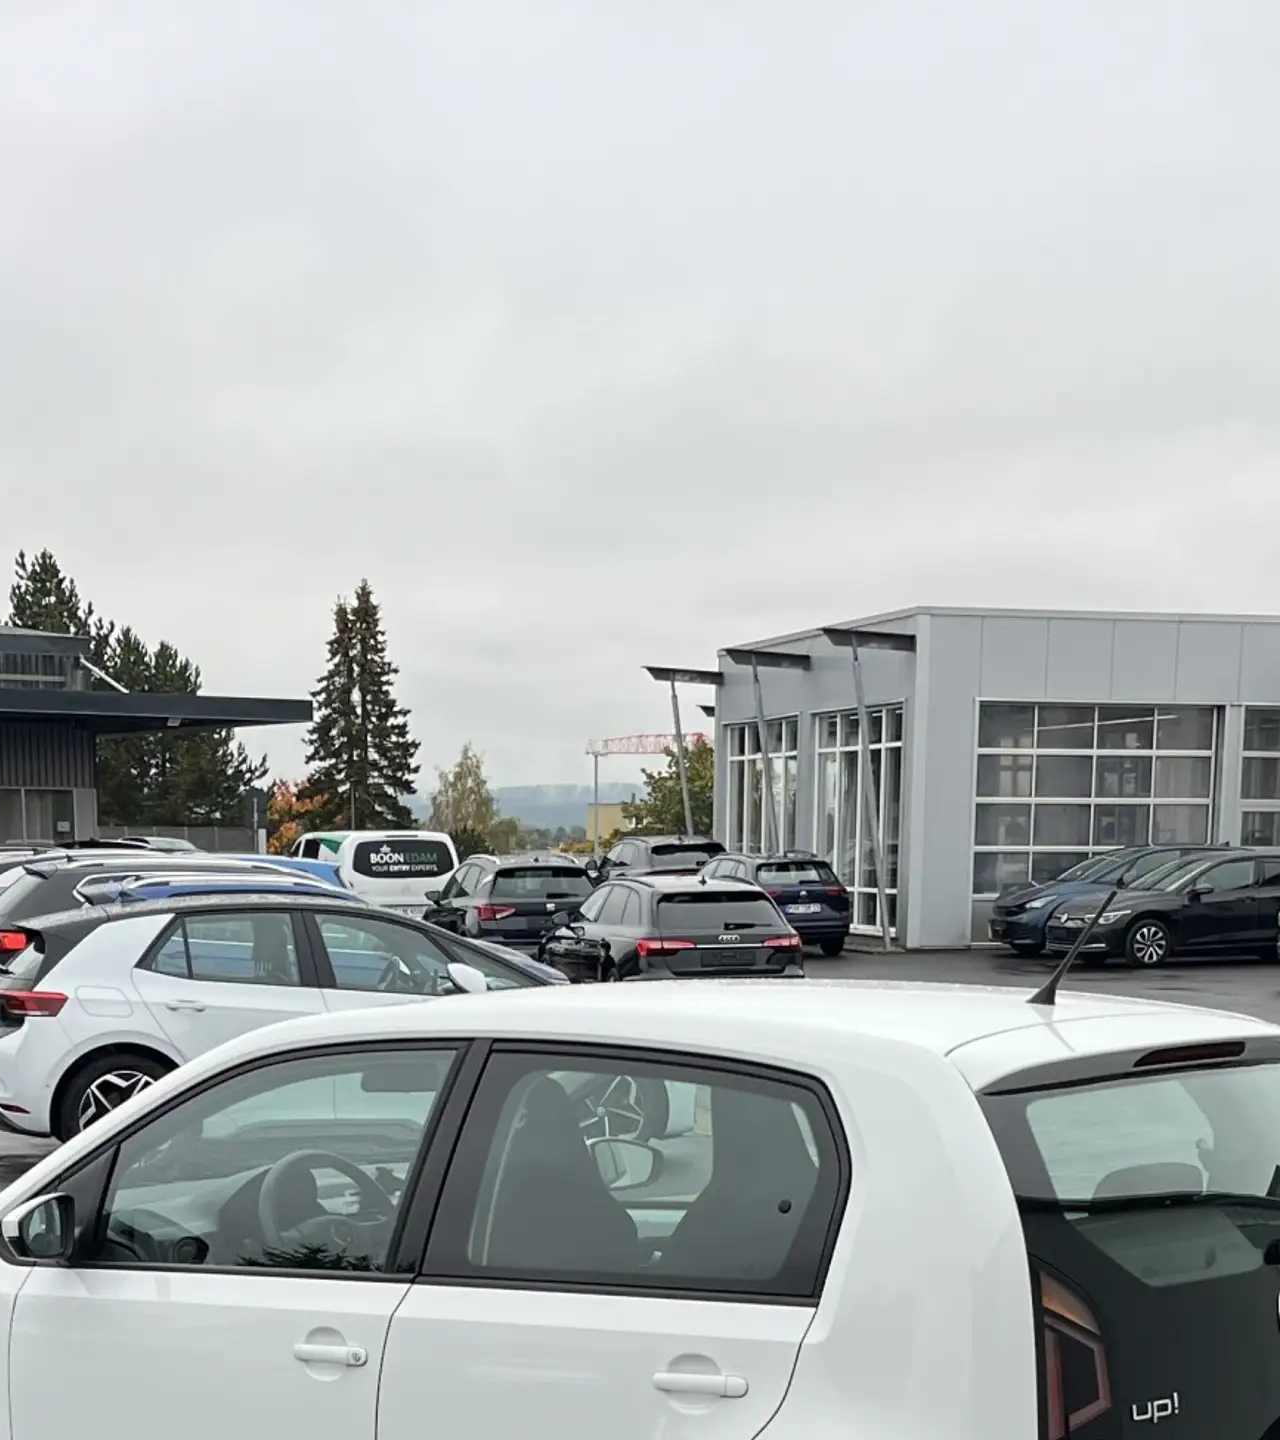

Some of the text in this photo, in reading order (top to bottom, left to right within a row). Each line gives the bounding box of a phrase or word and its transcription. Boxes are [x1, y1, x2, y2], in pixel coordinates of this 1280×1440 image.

[369, 851, 438, 864] BOON EDAM
[1132, 1391, 1179, 1424] up!
